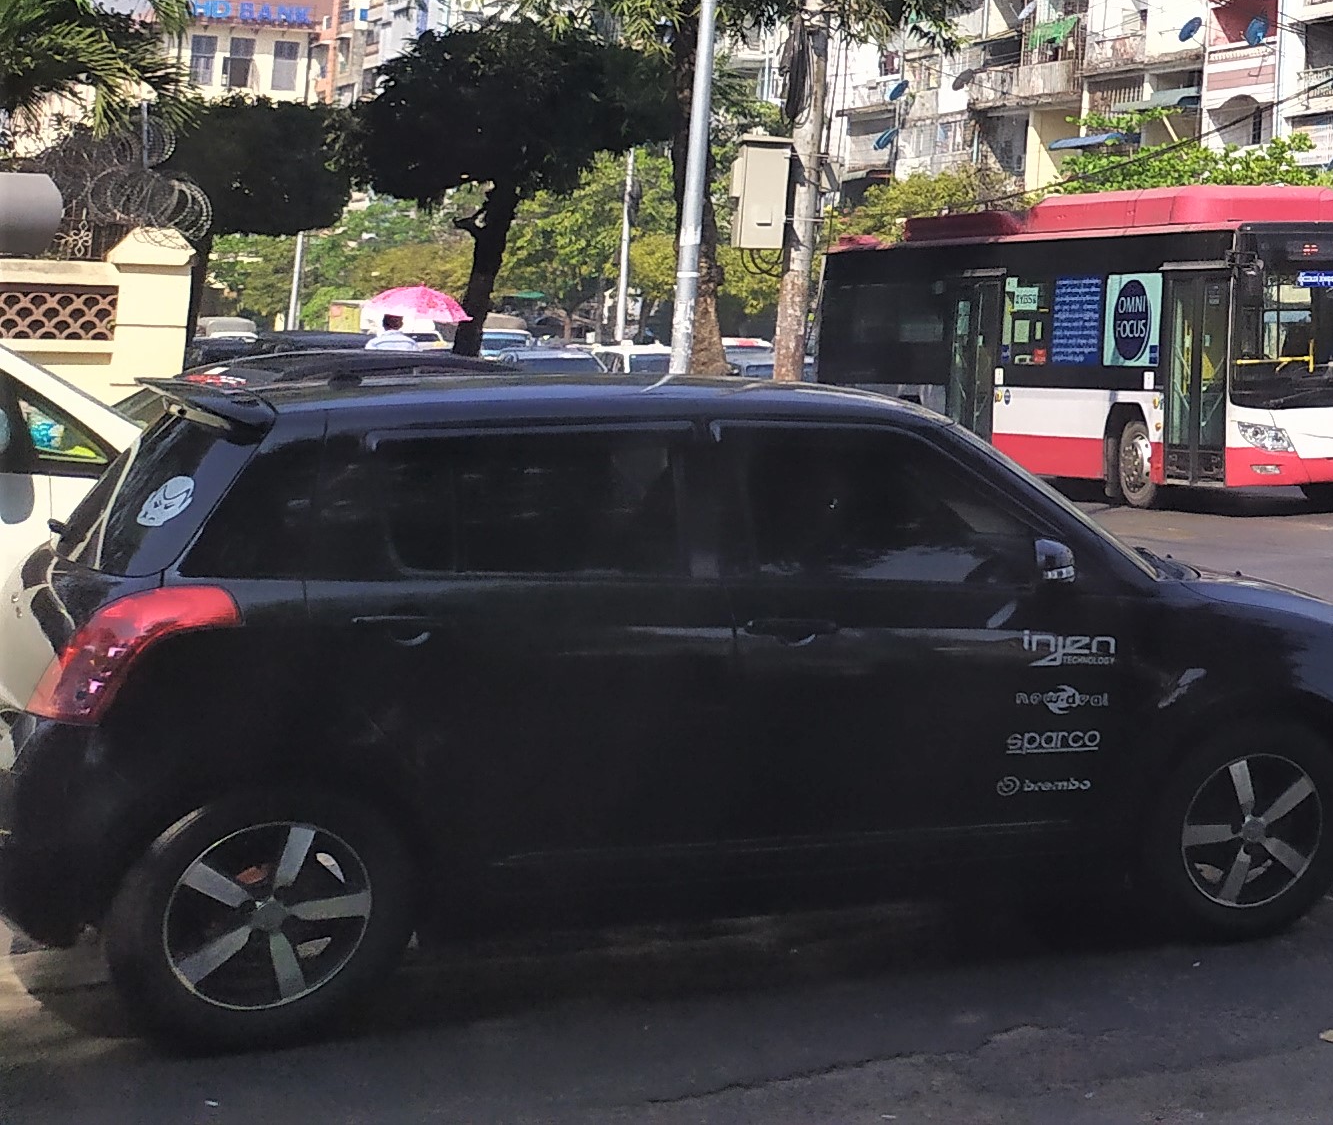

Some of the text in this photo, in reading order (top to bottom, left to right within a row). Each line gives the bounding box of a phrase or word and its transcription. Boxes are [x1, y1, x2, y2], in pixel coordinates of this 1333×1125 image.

[239, 1, 313, 23] BANK
[1117, 295, 1146, 313] OMNI
[1115, 319, 1146, 338] FOCUS
[1062, 655, 1116, 665] TECHNOLOGY
[1006, 730, 1101, 754] sparco
[1023, 777, 1092, 792] brembo
